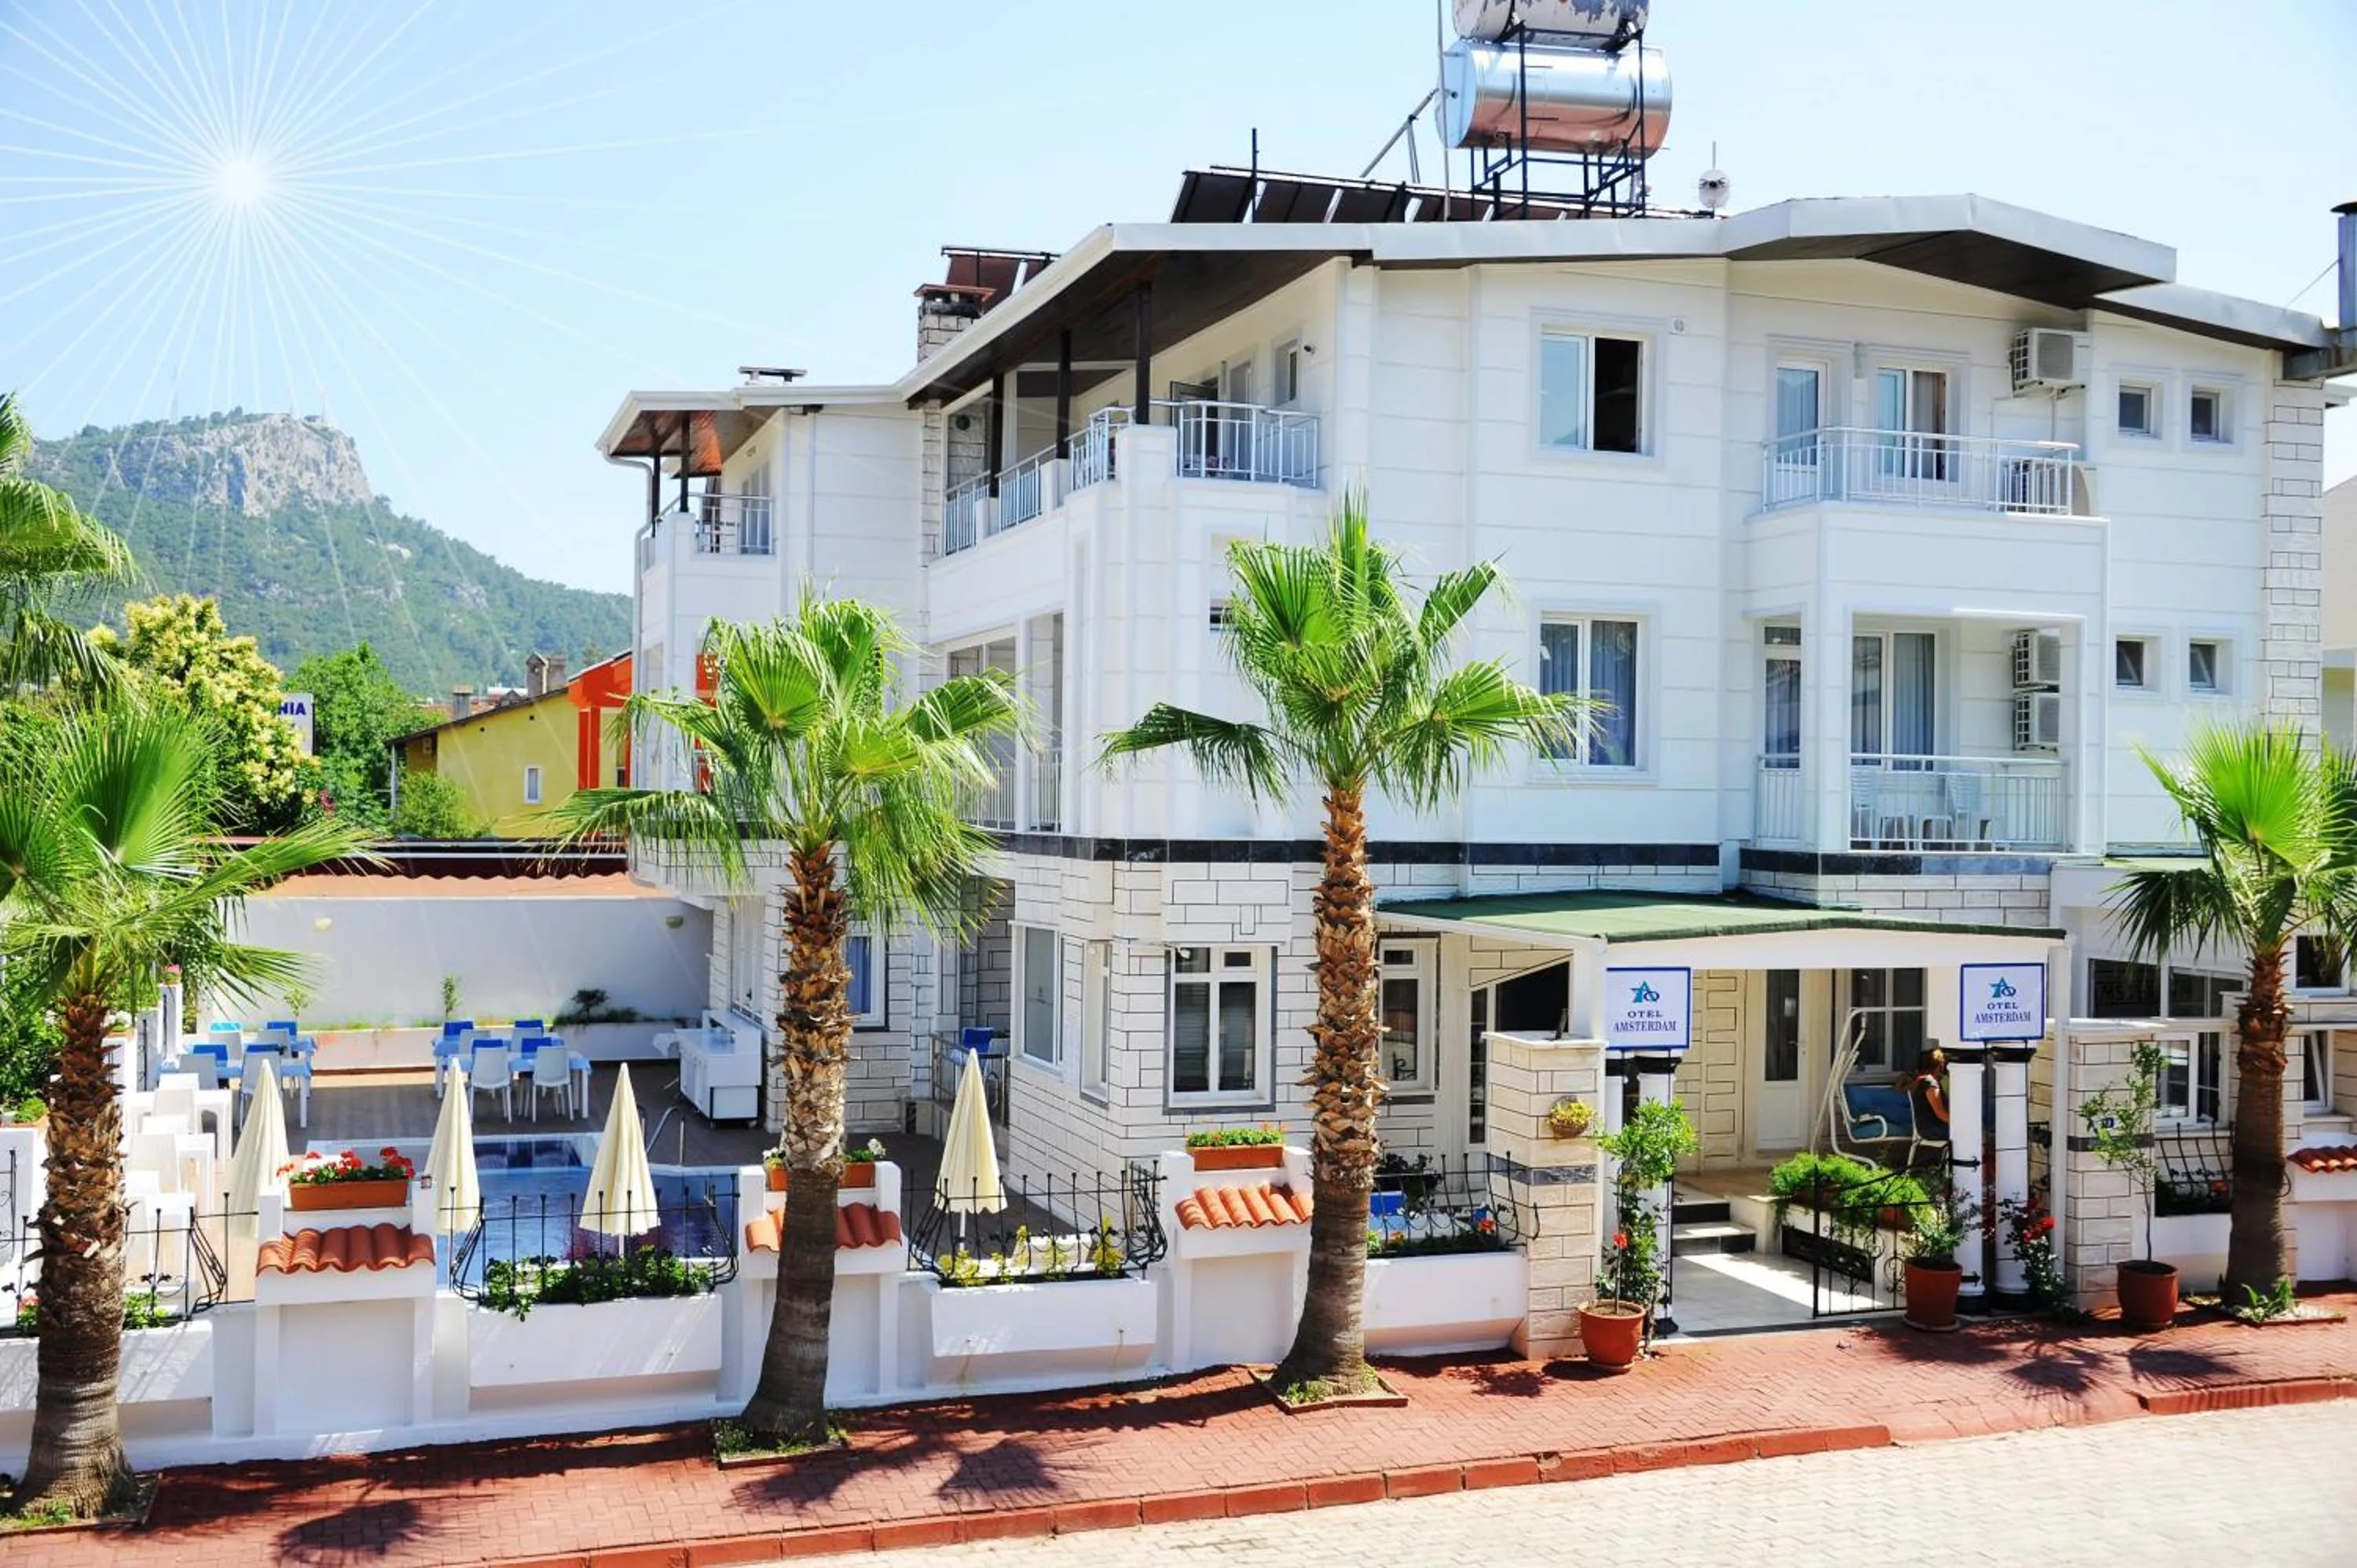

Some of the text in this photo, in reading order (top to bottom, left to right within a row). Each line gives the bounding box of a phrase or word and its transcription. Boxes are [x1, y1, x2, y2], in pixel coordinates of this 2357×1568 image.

[1987, 1002, 2018, 1010] OTEL
[1627, 1009, 1663, 1019] OTEL
[1974, 1010, 2031, 1023] AMSTERDAM
[1613, 1020, 1677, 1032] AMSTERDAM
